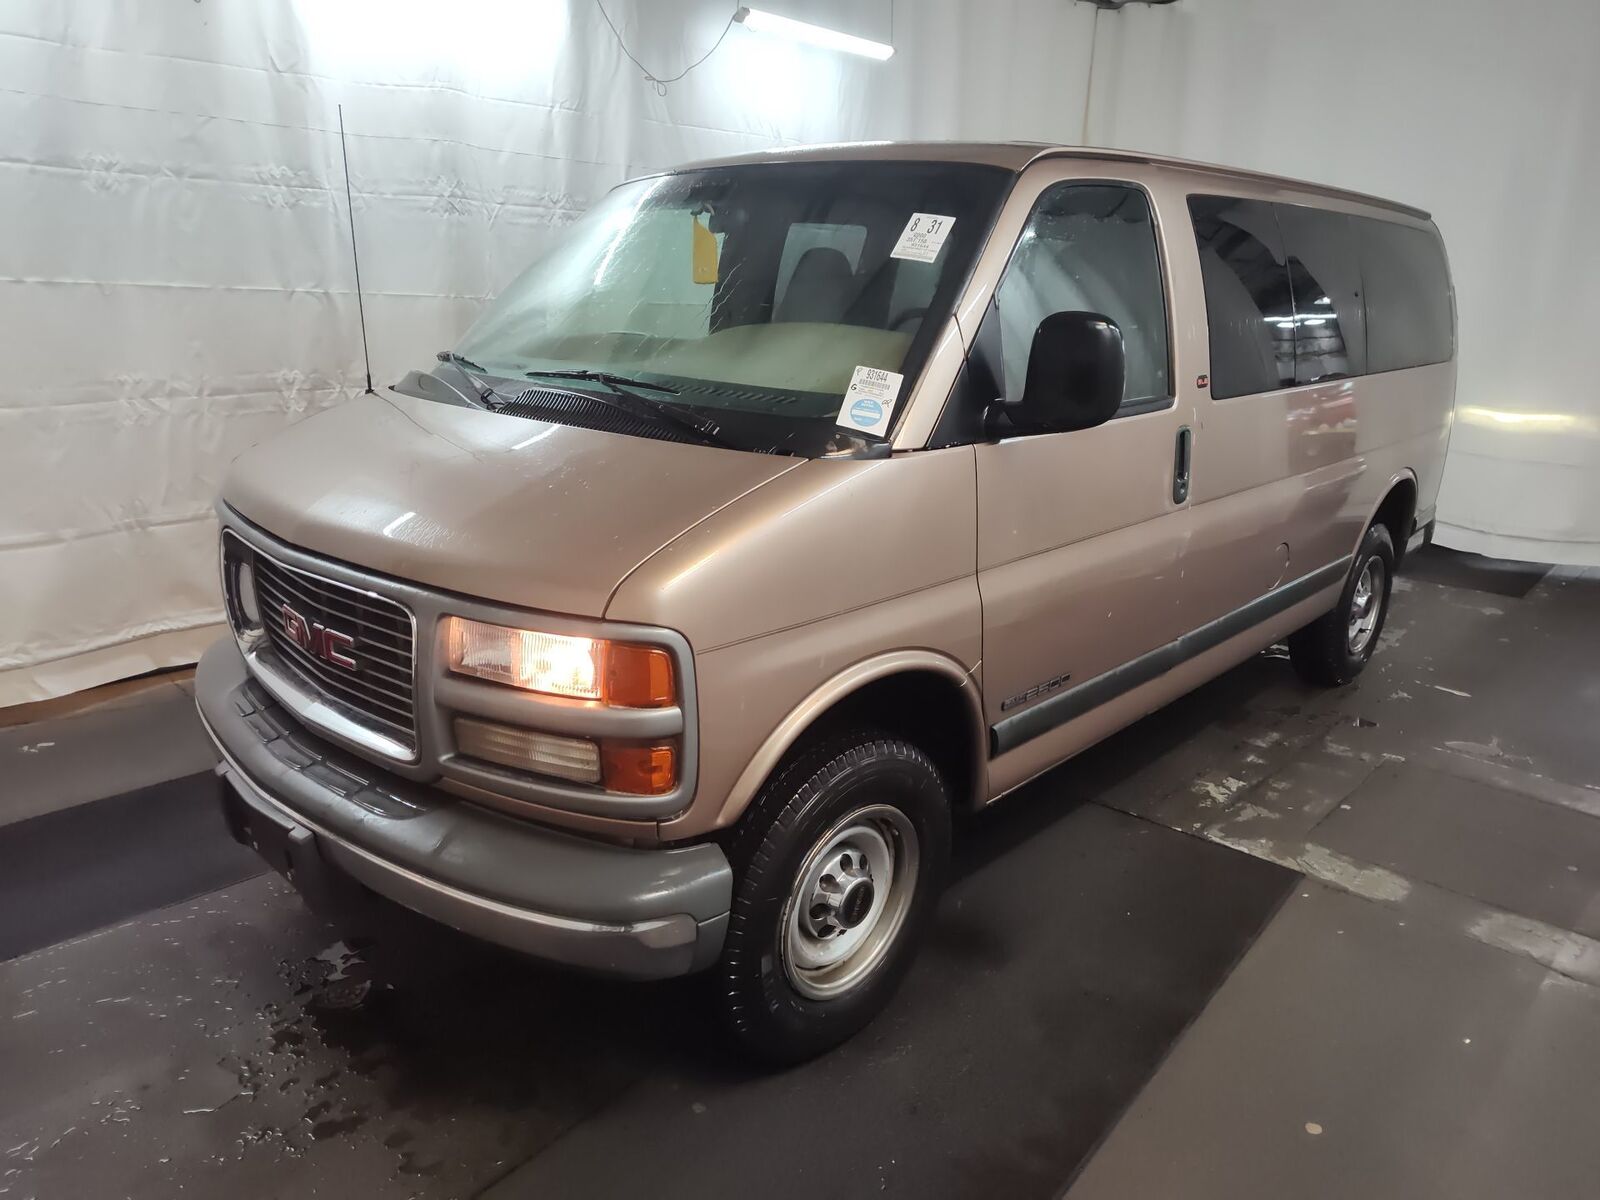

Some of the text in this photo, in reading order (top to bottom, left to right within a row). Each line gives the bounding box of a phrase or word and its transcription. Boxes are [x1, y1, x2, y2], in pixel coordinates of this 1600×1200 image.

[910, 217, 943, 234] 8 31
[281, 603, 357, 671] GMC
